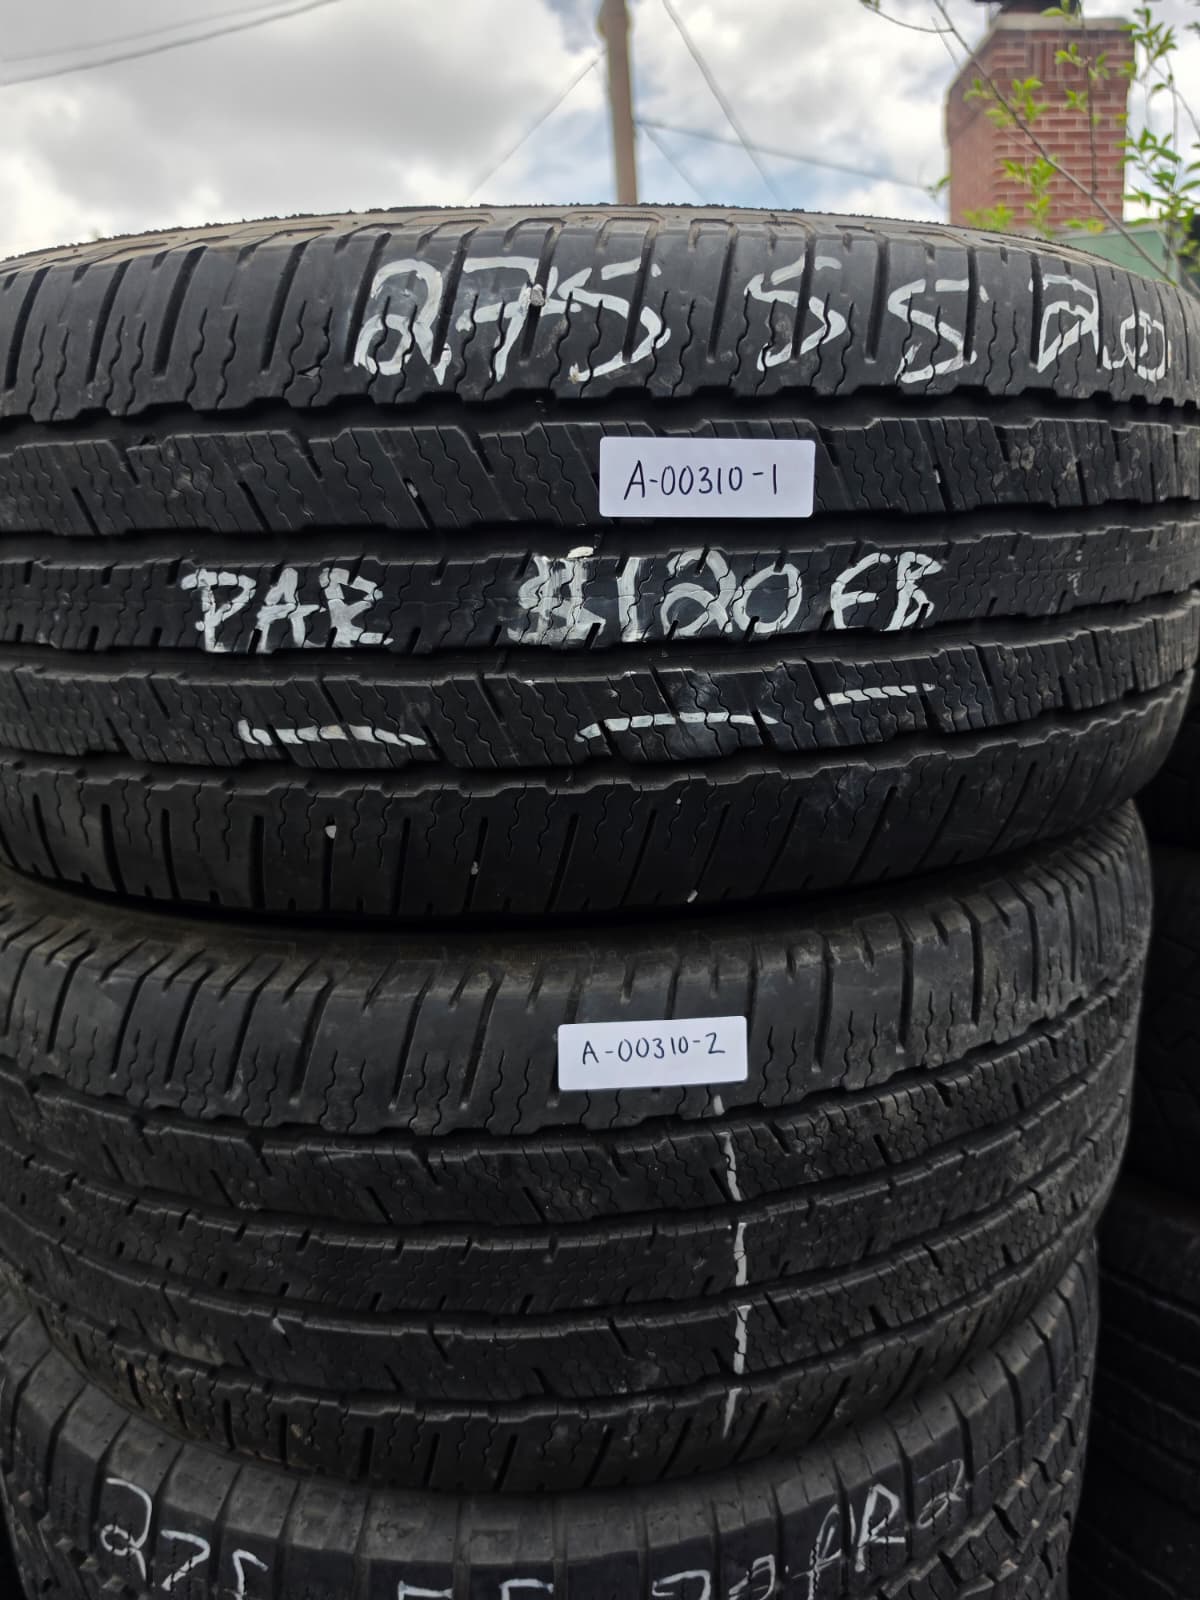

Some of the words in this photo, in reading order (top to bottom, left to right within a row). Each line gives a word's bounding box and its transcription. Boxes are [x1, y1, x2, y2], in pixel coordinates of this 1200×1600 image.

[353, 257, 672, 385] 275
[623, 460, 778, 501] A-00310-1
[181, 566, 394, 652] PAR
[582, 1032, 726, 1065] A-00310-2
